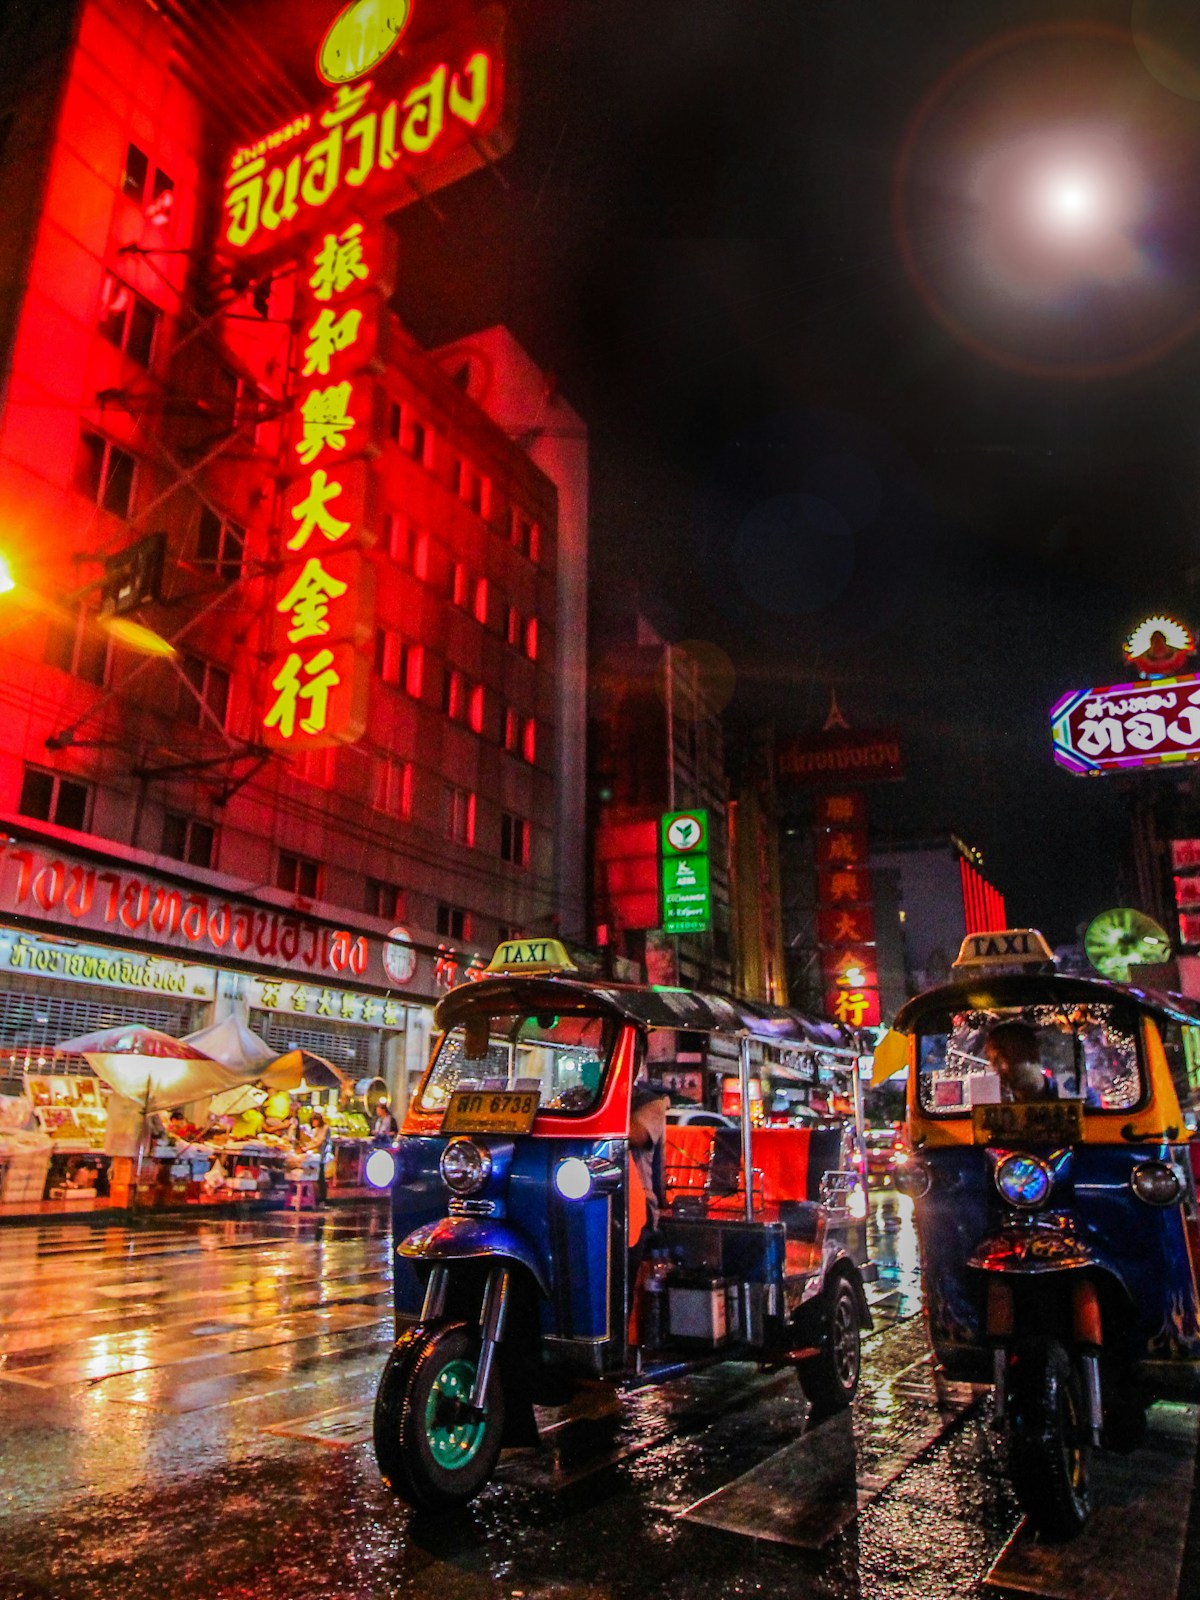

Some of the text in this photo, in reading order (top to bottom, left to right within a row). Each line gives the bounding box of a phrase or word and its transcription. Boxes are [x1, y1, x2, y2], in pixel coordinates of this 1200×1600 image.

[502, 943, 549, 964] TAXI
[973, 934, 1030, 956] TAXI
[489, 1096, 532, 1114] 6738
